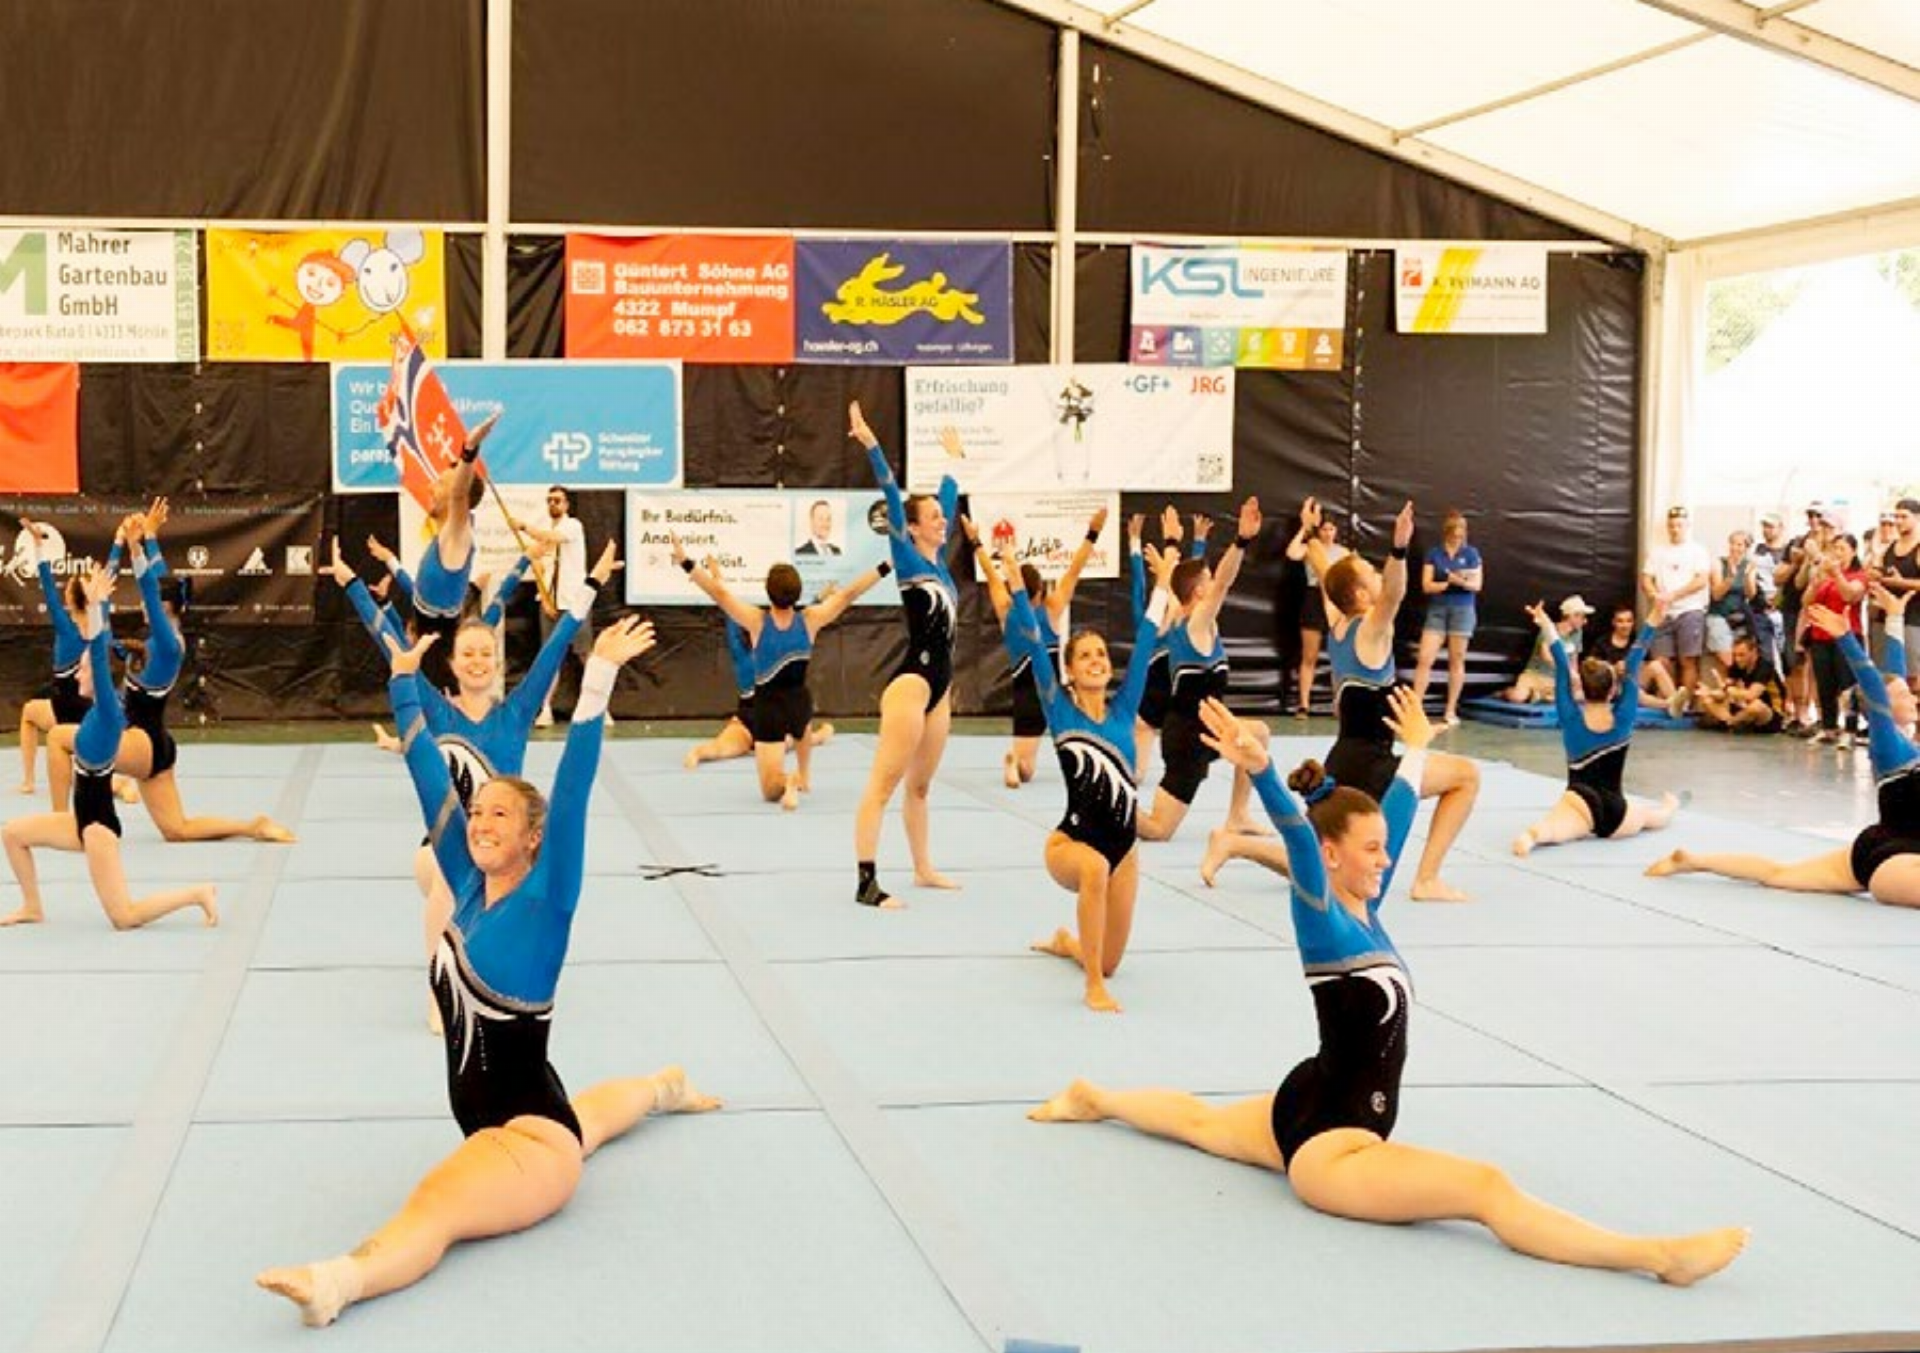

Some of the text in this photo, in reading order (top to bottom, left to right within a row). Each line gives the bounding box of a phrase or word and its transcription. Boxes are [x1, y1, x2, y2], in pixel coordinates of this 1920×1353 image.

[58, 232, 131, 255] Mahrer
[59, 264, 168, 287] Gartenbau
[613, 263, 789, 280] Güntert Söhne AG
[1141, 256, 1264, 298] KSL
[614, 280, 789, 299] Bauunternehmung
[59, 294, 119, 316] GmbH
[613, 302, 736, 318] 4322 Mumpf
[921, 296, 939, 308] AG
[613, 319, 649, 336] 062
[659, 320, 695, 336] 873
[701, 320, 722, 336] 31
[350, 381, 375, 394] Wir
[914, 379, 1009, 396] Erfrischung
[1190, 376, 1226, 394] JRG
[914, 397, 985, 415] gefällig?
[350, 417, 371, 433] Ein
[641, 508, 738, 523] Ihr Bedürfnis.
